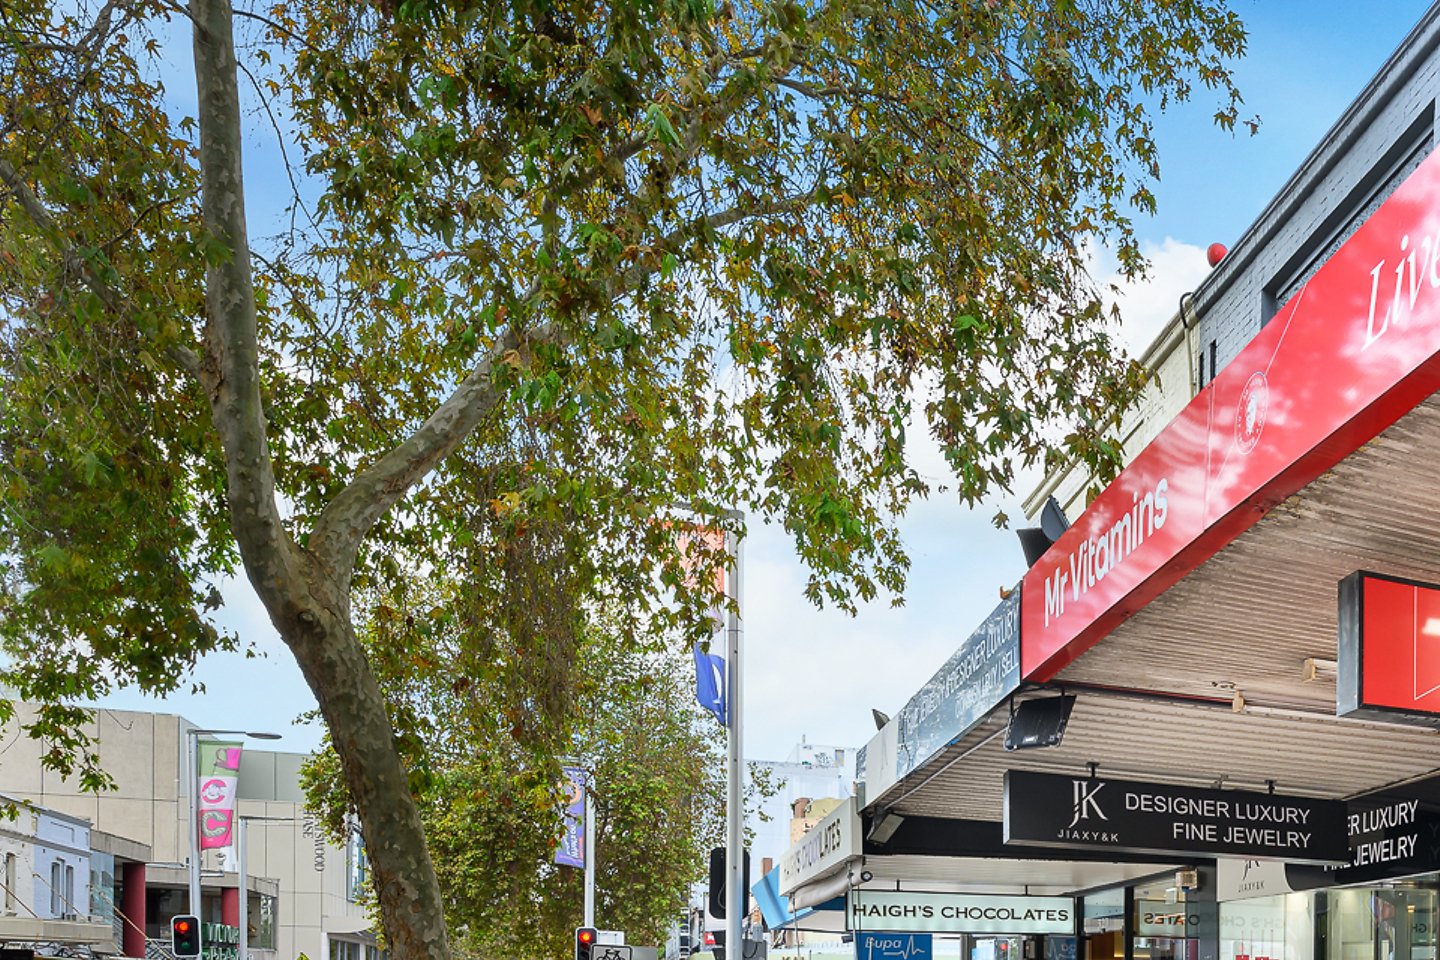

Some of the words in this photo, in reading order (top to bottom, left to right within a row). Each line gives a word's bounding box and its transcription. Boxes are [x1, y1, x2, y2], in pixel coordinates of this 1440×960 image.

[1044, 566, 1069, 629] Mr
[1069, 477, 1169, 602] Vitamins
[1125, 793, 1230, 819] DESIGNER
[1235, 804, 1311, 825] LUXURY
[1362, 799, 1419, 832] LUXURY
[1057, 828, 1119, 843] JIAXY&K
[1173, 822, 1218, 843] FINE
[1223, 827, 1312, 849] JEWELRY
[1353, 833, 1418, 868] JEWELRY
[853, 904, 934, 919] HAIGH'S
[941, 906, 1069, 922] CHOCOLATES
[864, 936, 902, 952] Bupa
